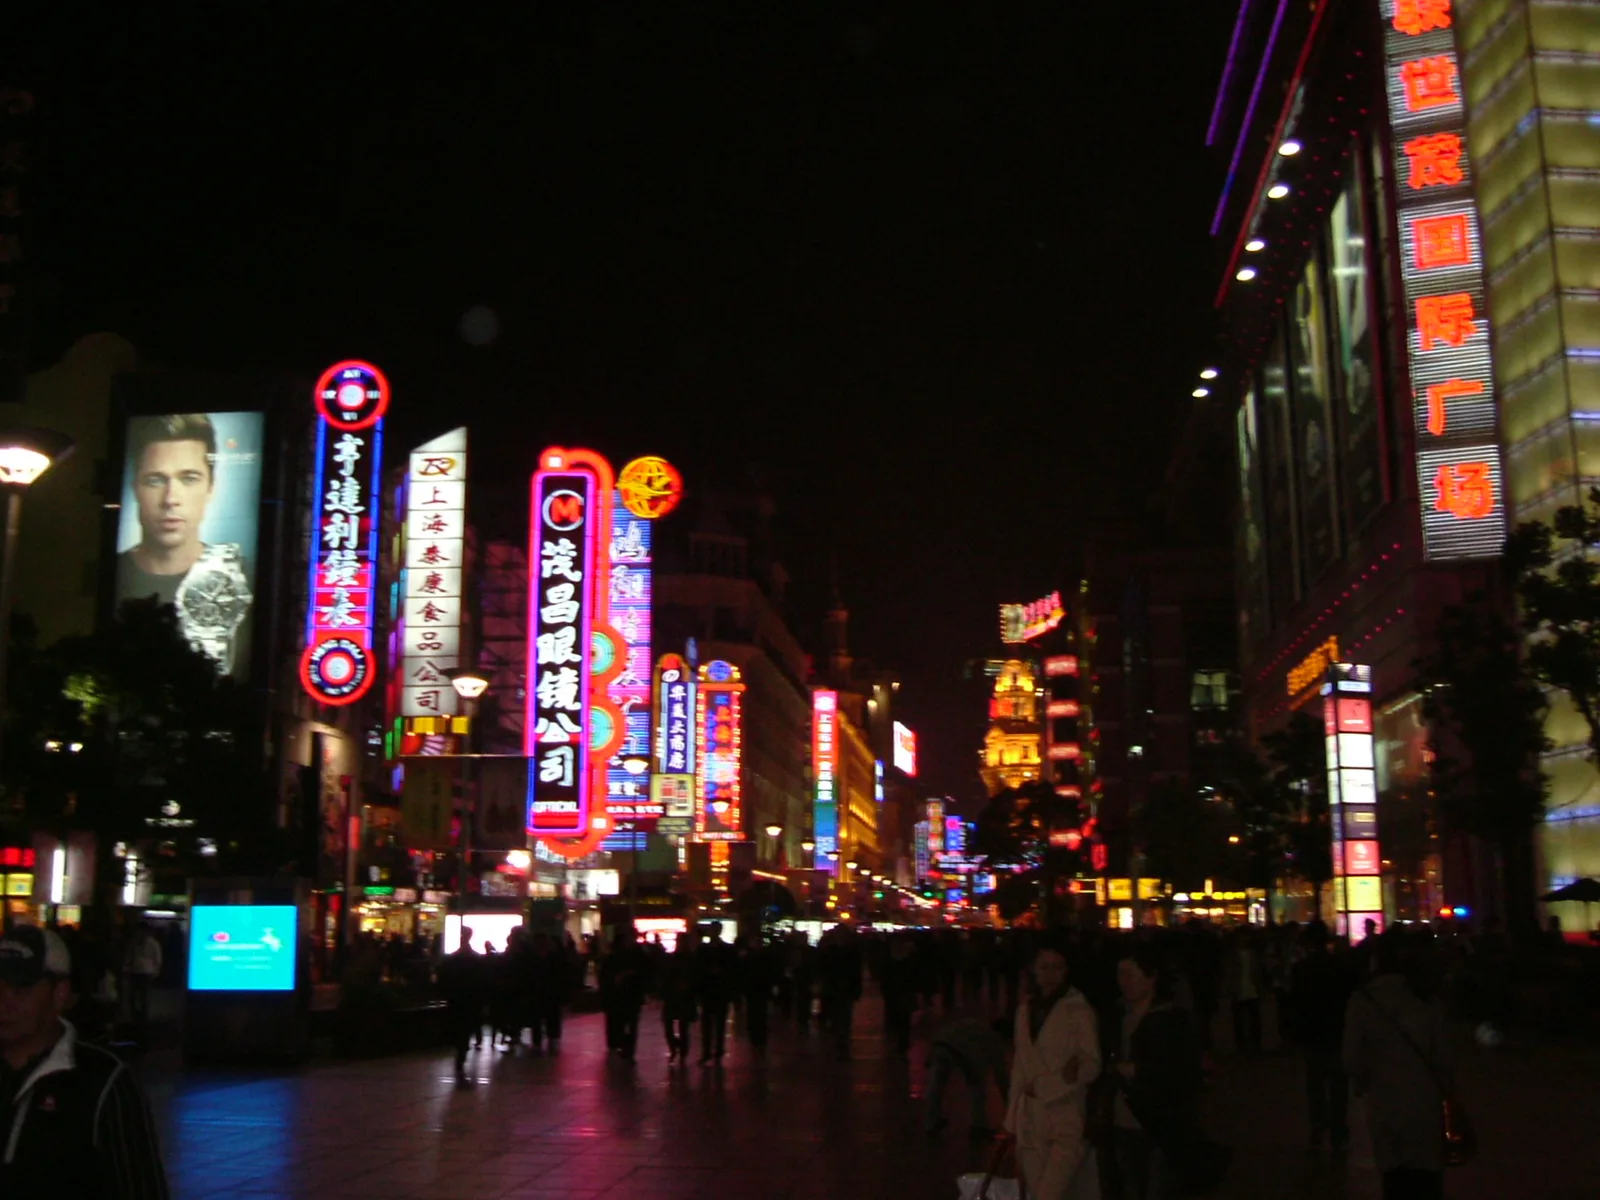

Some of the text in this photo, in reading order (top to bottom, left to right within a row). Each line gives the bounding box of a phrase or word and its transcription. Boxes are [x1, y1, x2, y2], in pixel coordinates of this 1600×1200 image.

[412, 486, 451, 711] 上海泰康食品公司
[534, 538, 582, 787] 茂昌眼镜公司
